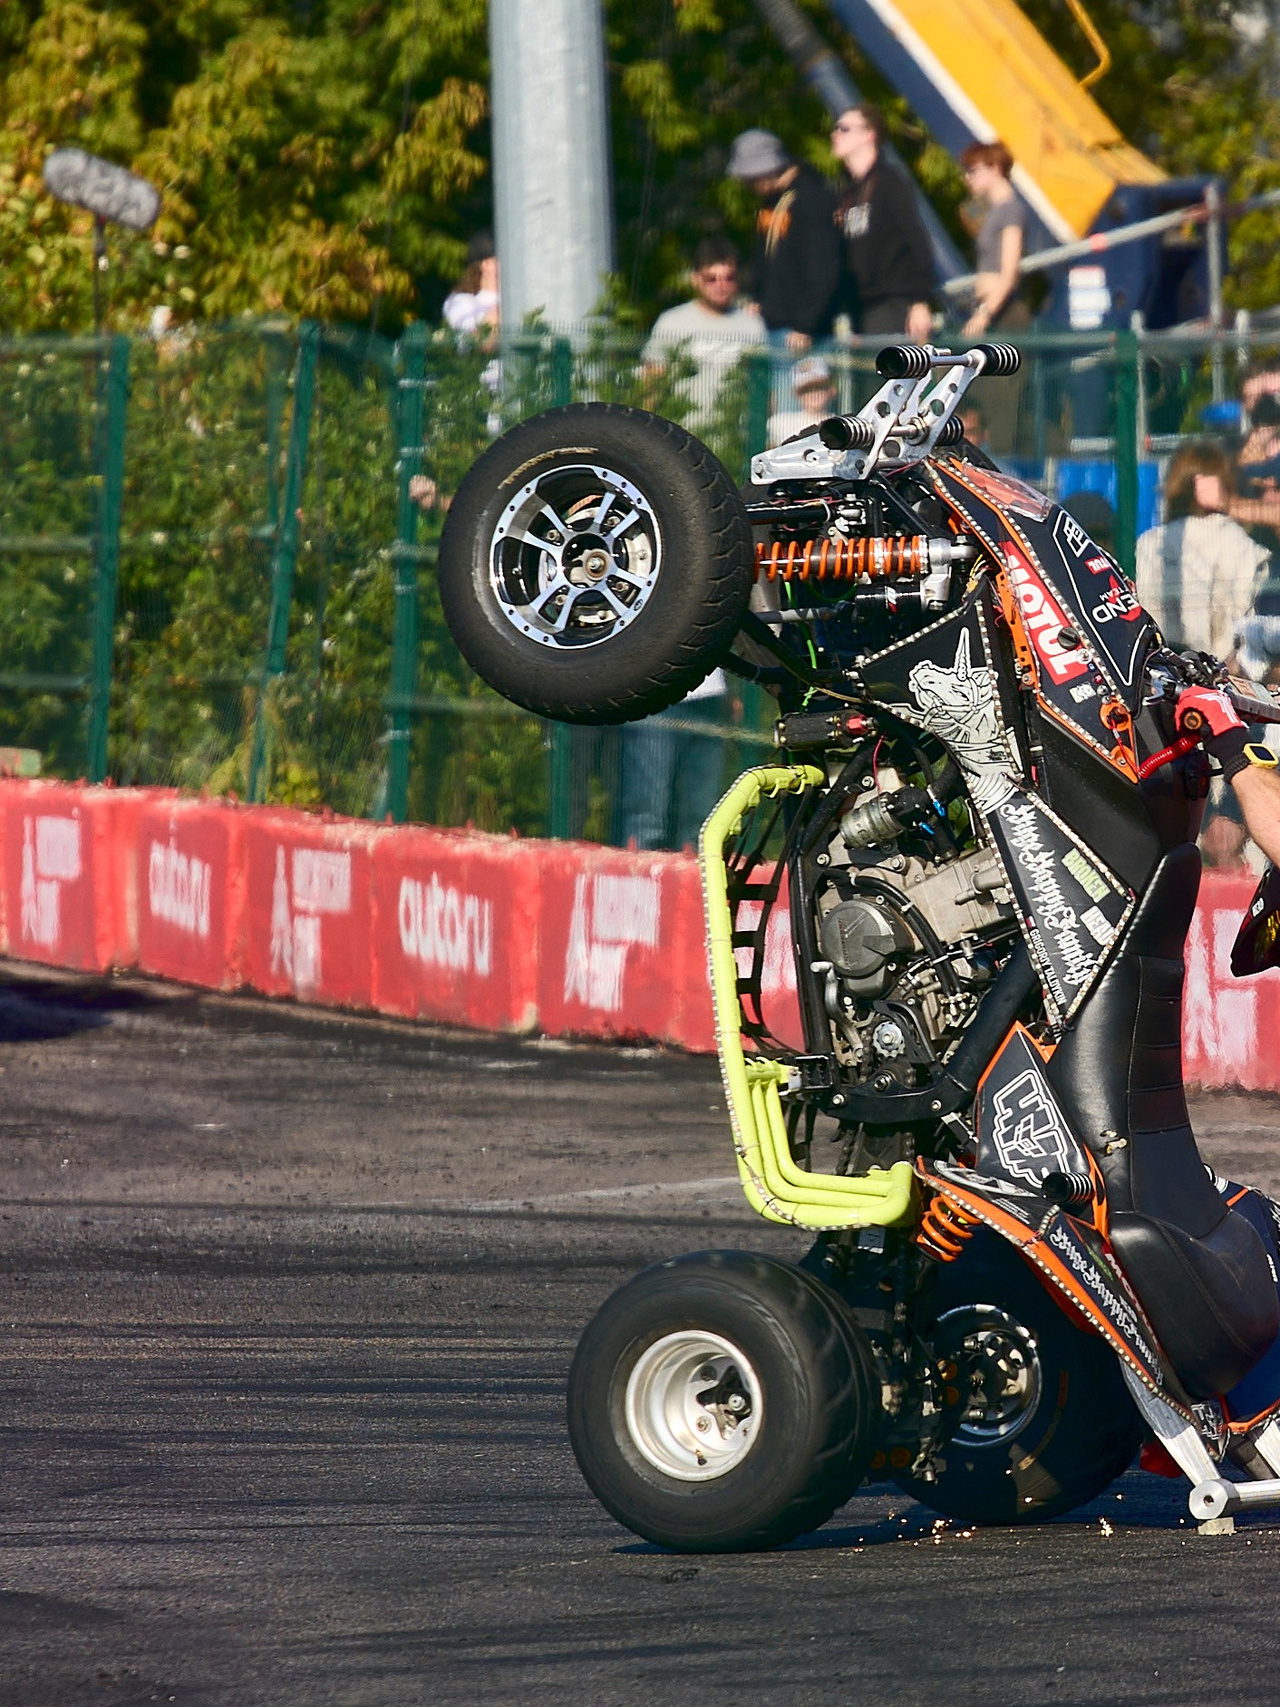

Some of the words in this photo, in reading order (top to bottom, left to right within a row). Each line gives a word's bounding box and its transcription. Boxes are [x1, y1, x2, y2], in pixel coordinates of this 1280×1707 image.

[1089, 556, 1114, 573] TUL
[1007, 553, 1088, 676] MOTUL
[1092, 595, 1140, 624] END
[1061, 847, 1110, 903] BROKEN
[1030, 928, 1051, 968] GRIGORIY
